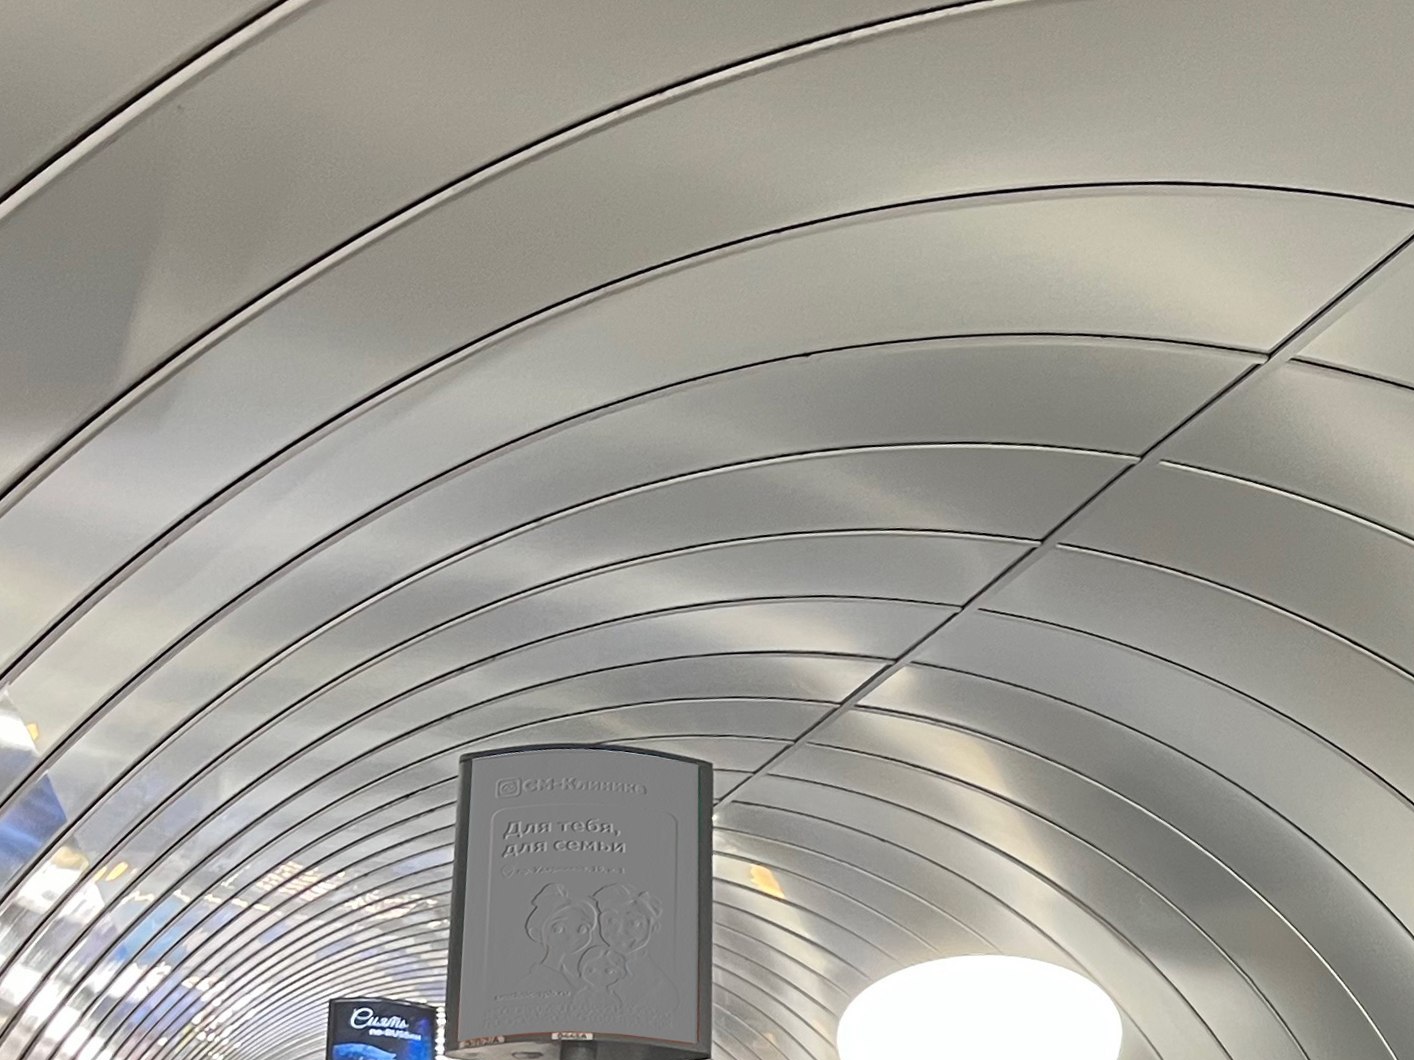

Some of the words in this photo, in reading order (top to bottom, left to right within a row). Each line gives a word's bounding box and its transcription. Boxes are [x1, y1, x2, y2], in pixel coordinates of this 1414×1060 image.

[503, 819, 552, 840] Для
[557, 818, 622, 837] тебя,
[501, 840, 548, 858] для
[553, 839, 626, 854] семьи
[350, 1007, 409, 1029] Сиять
